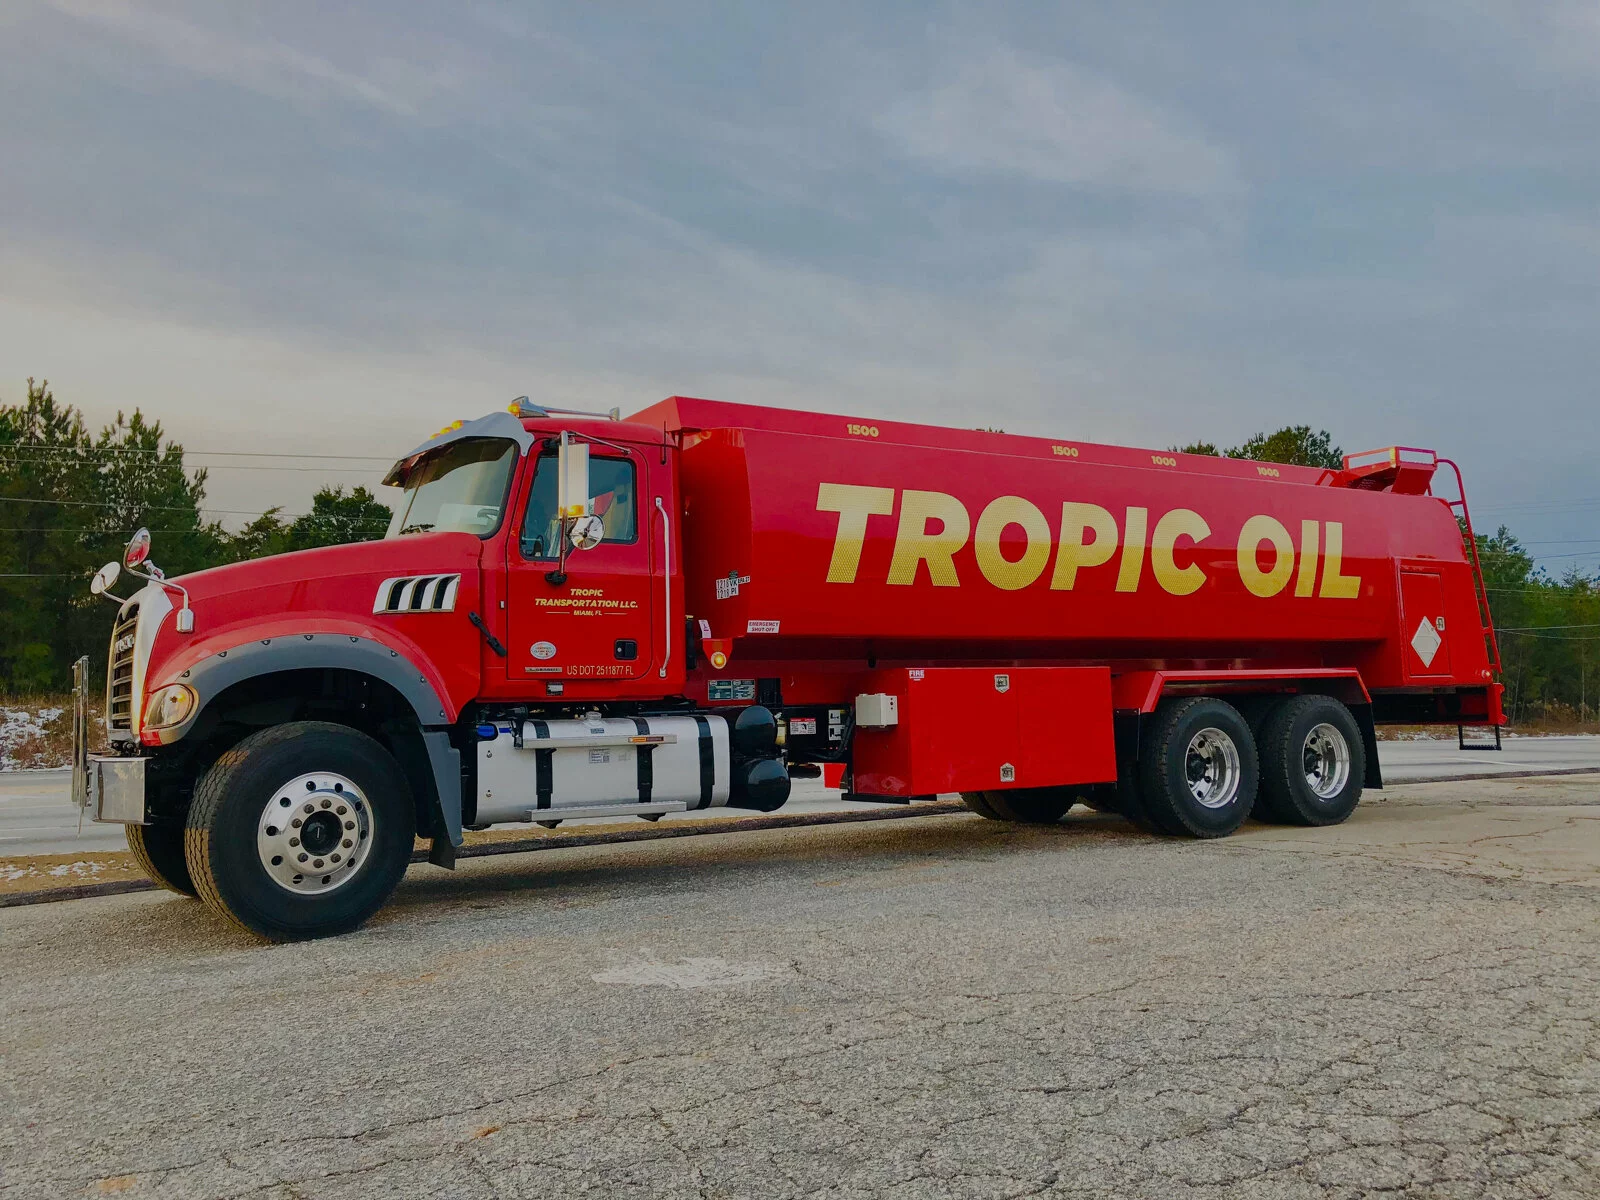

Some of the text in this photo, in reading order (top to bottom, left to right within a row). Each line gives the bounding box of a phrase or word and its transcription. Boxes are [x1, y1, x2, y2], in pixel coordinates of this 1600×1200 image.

[846, 423, 880, 438] 1500
[1051, 445, 1079, 458] 1500
[1151, 455, 1176, 468] 1000
[1256, 466, 1280, 479] 1000
[815, 482, 1362, 600] TROPIC OIL
[570, 588, 603, 596] TROPIC
[534, 598, 638, 608] TRANSPORTATION LLC.
[573, 609, 594, 617] MIAMI,
[567, 666, 578, 675] US
[580, 666, 595, 675] DOT
[597, 666, 624, 675] 2511877
[626, 666, 634, 675] FL
